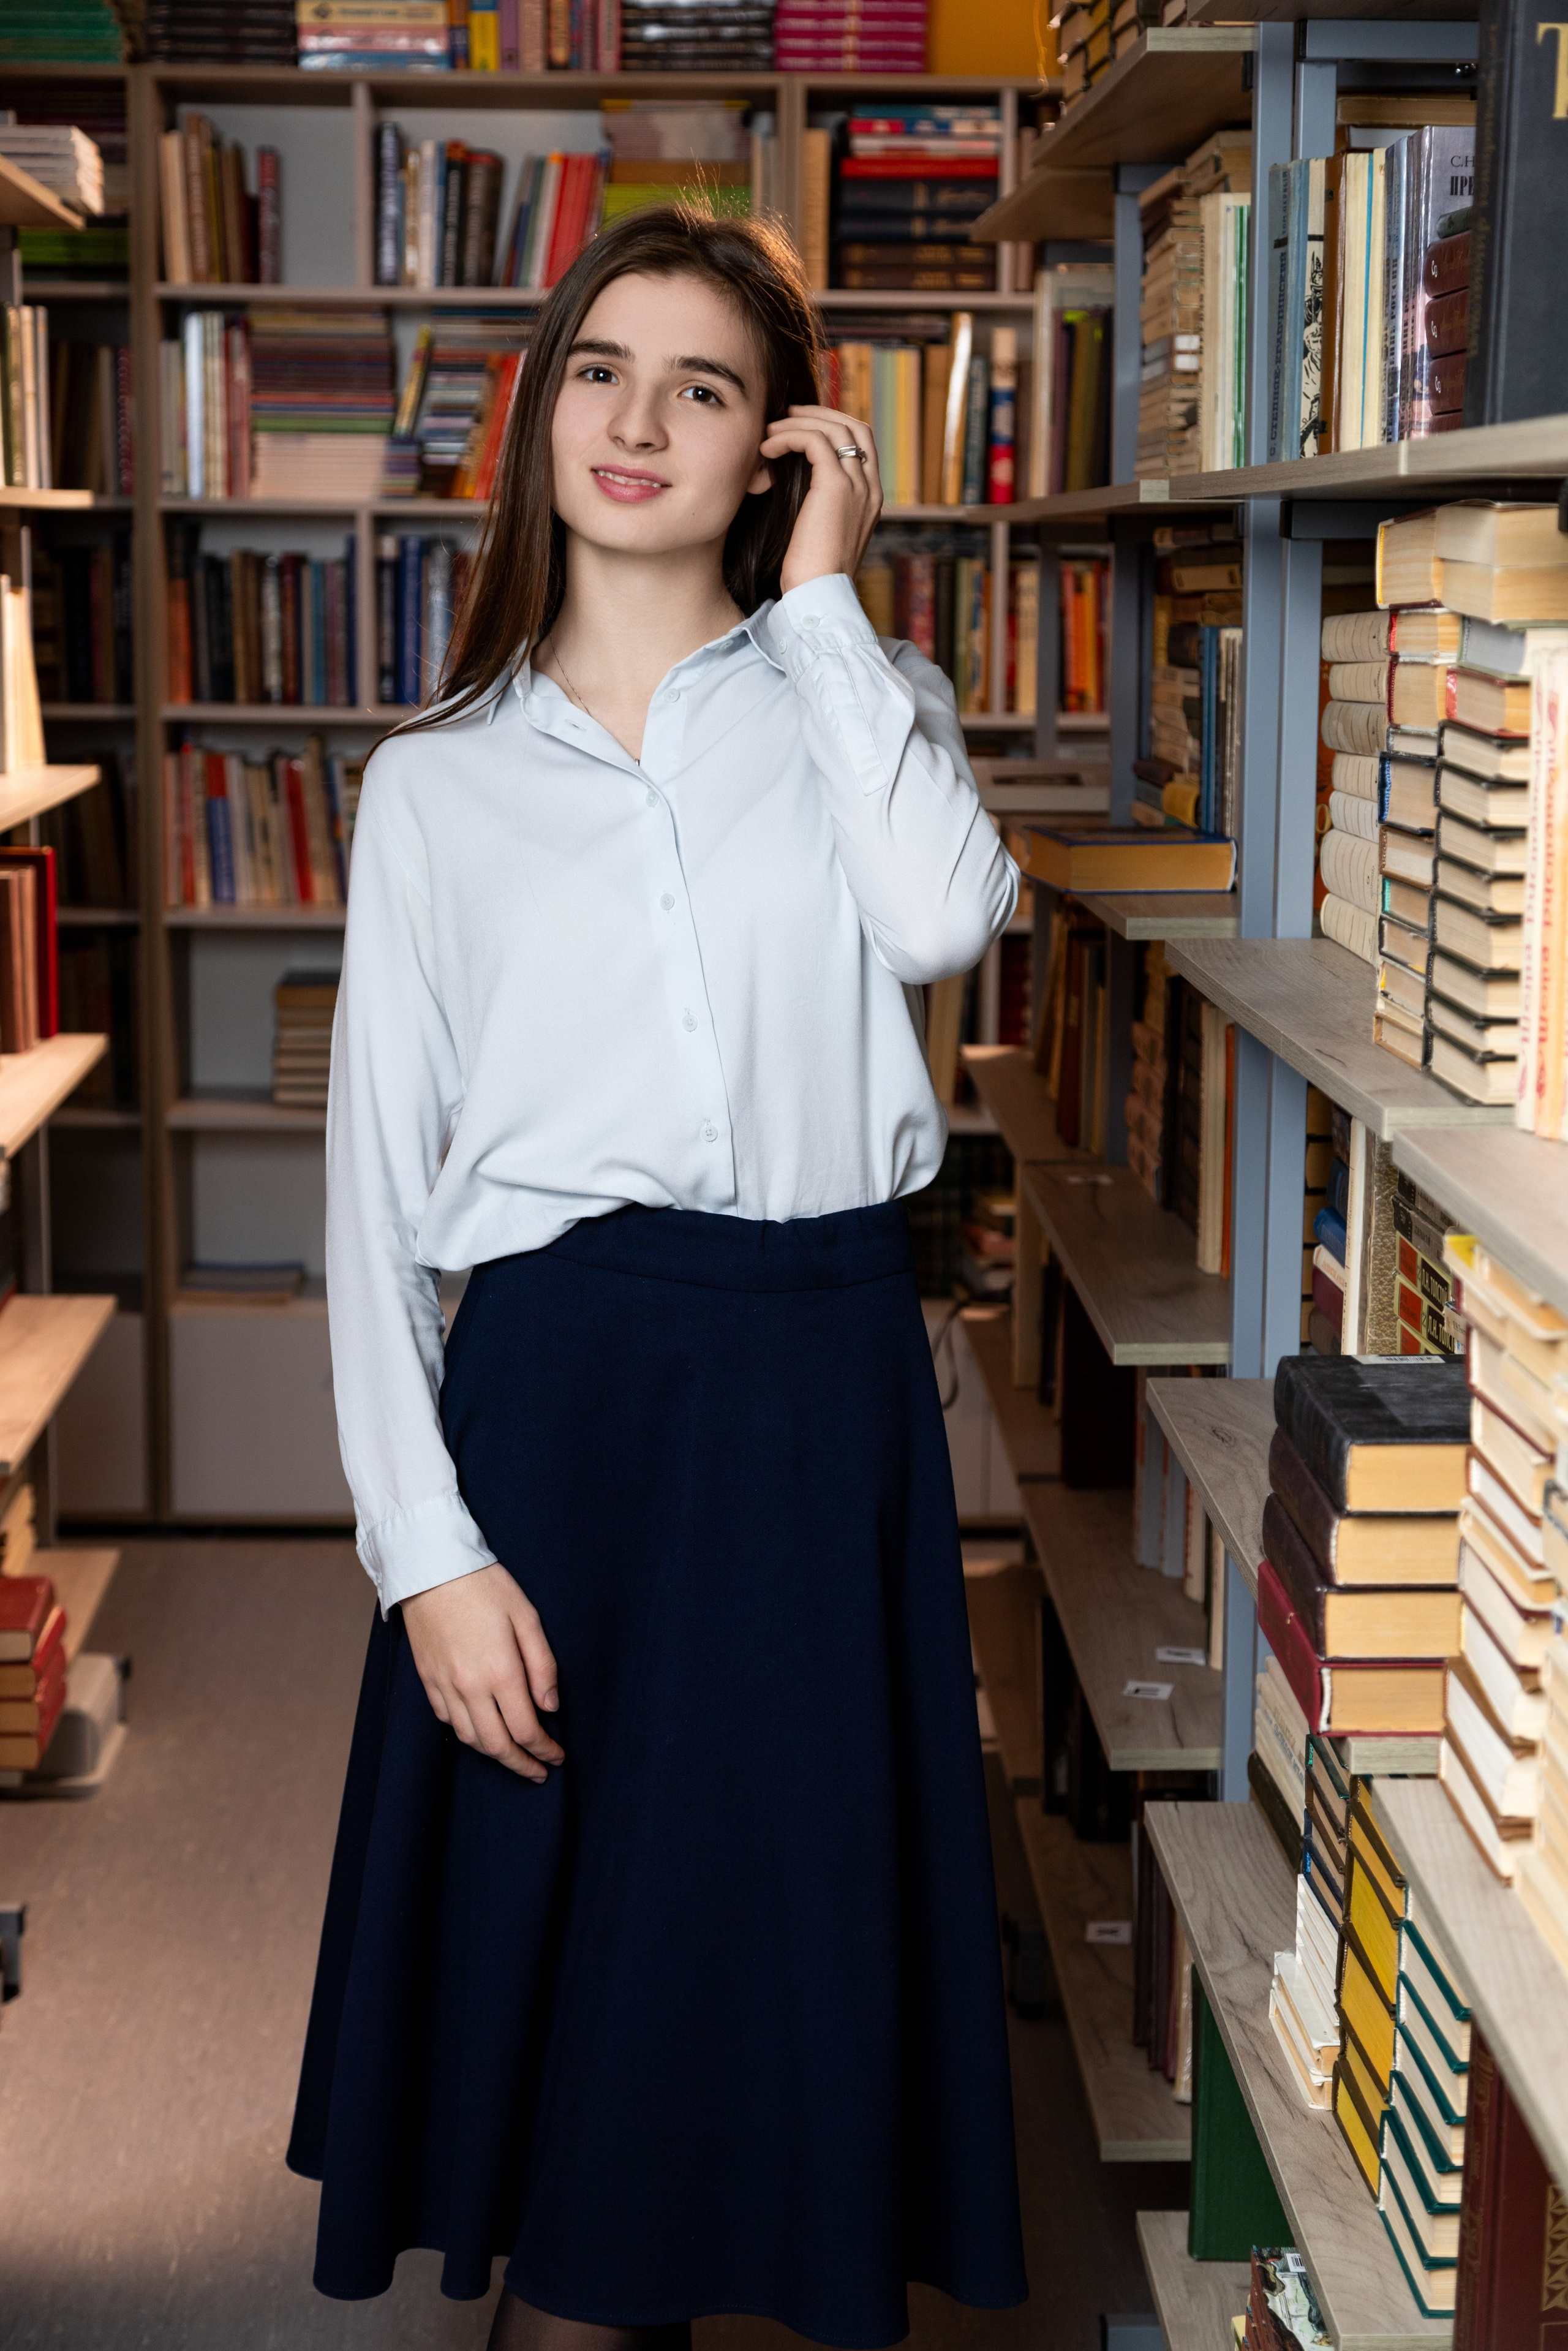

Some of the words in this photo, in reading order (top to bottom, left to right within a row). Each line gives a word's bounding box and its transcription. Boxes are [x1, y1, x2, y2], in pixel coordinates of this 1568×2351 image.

[1271, 251, 1287, 440] СТЕПНЯК-КРАВЧИНСКИЙ
[1430, 1276, 1448, 1305] ТОЛСТОЙ
[1428, 1315, 1439, 1340] Л.Н.
